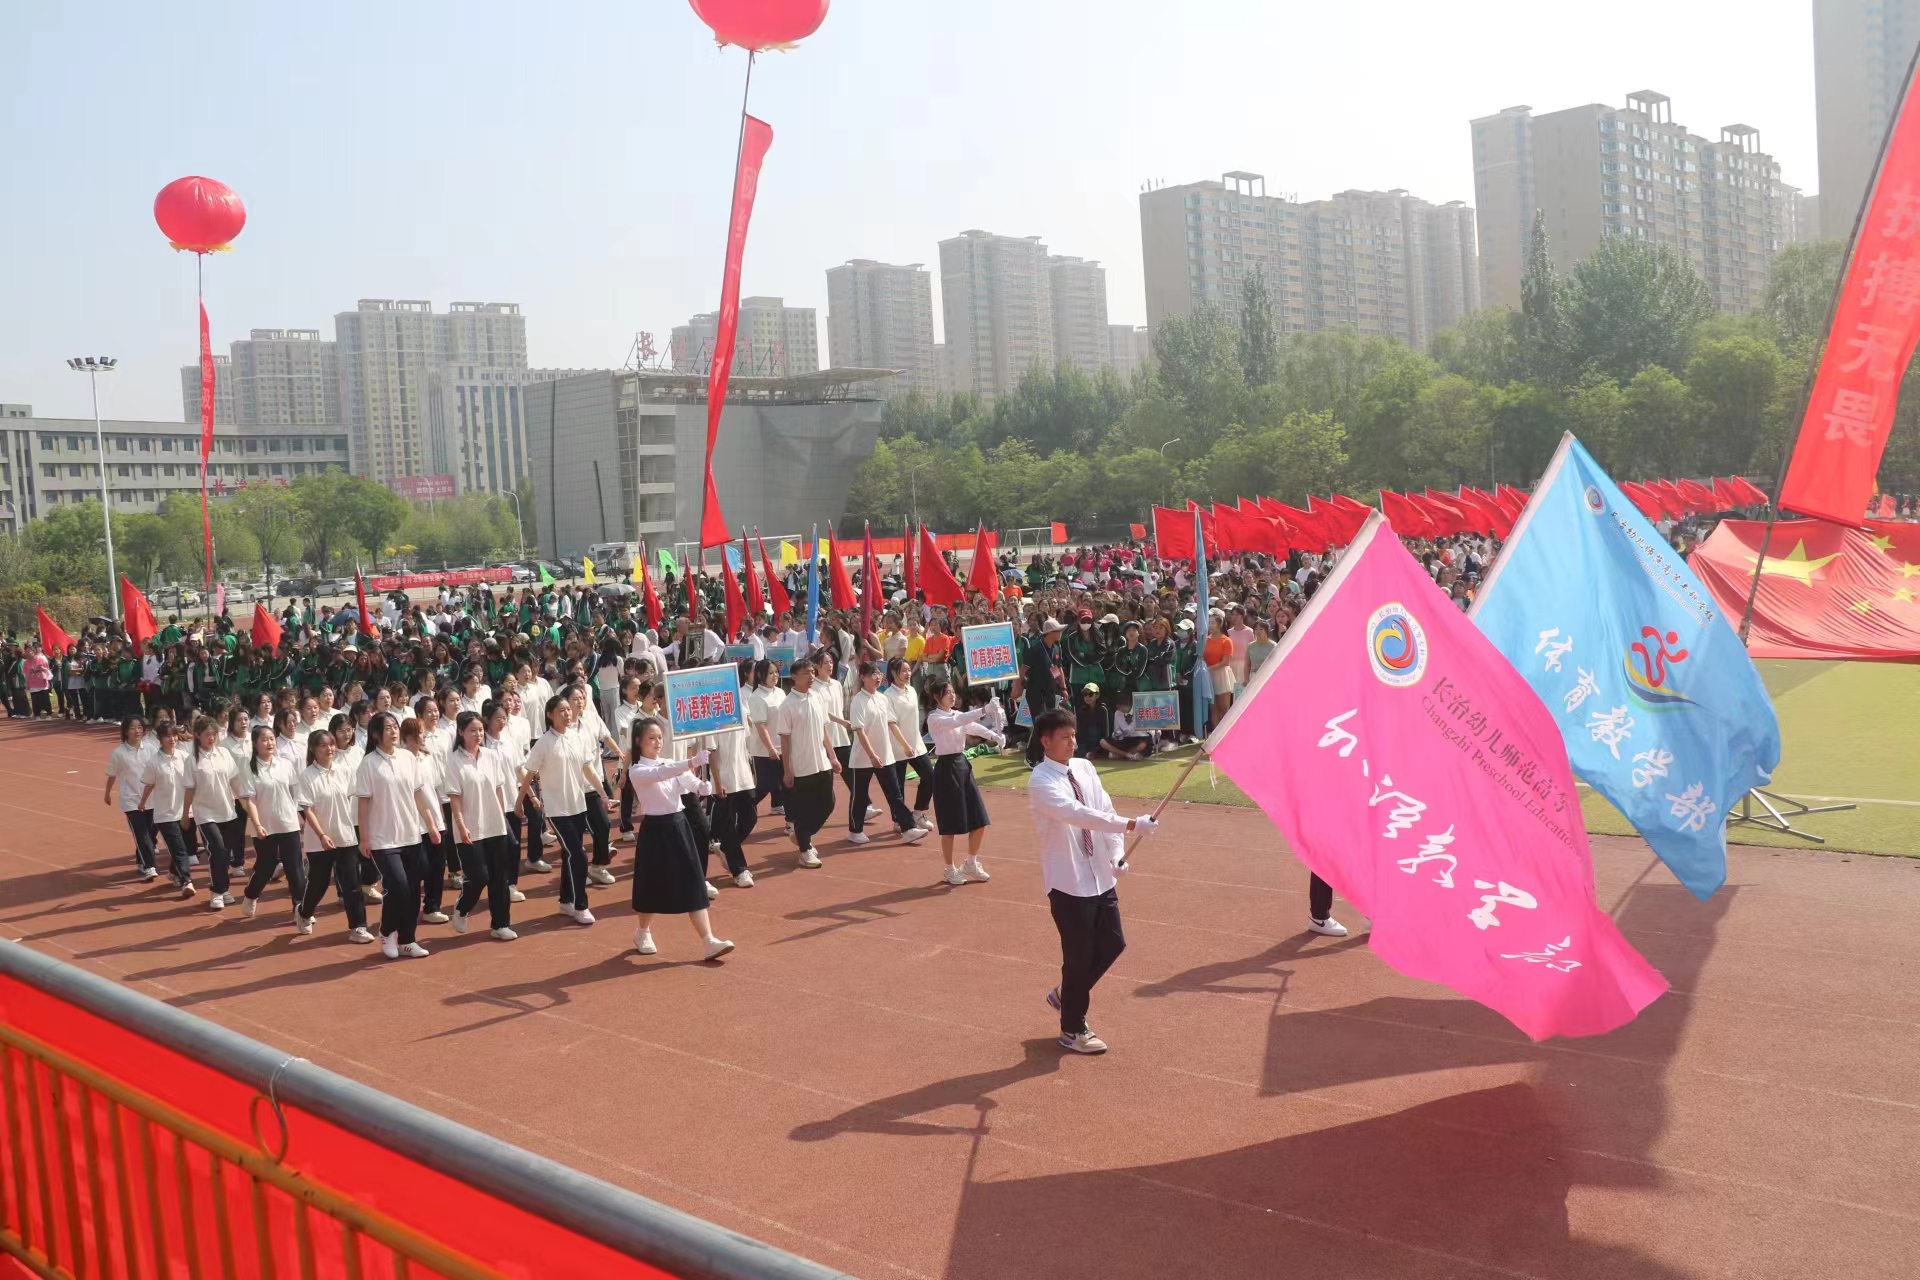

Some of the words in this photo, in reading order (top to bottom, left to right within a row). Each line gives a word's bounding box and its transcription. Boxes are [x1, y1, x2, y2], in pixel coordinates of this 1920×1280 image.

[970, 644, 1012, 670] 体育教学部
[675, 691, 735, 723] 外语教学部
[1535, 627, 1716, 832] 体育教学部
[1422, 696, 1473, 753] Changzhi
[1471, 749, 1527, 801] Preschool
